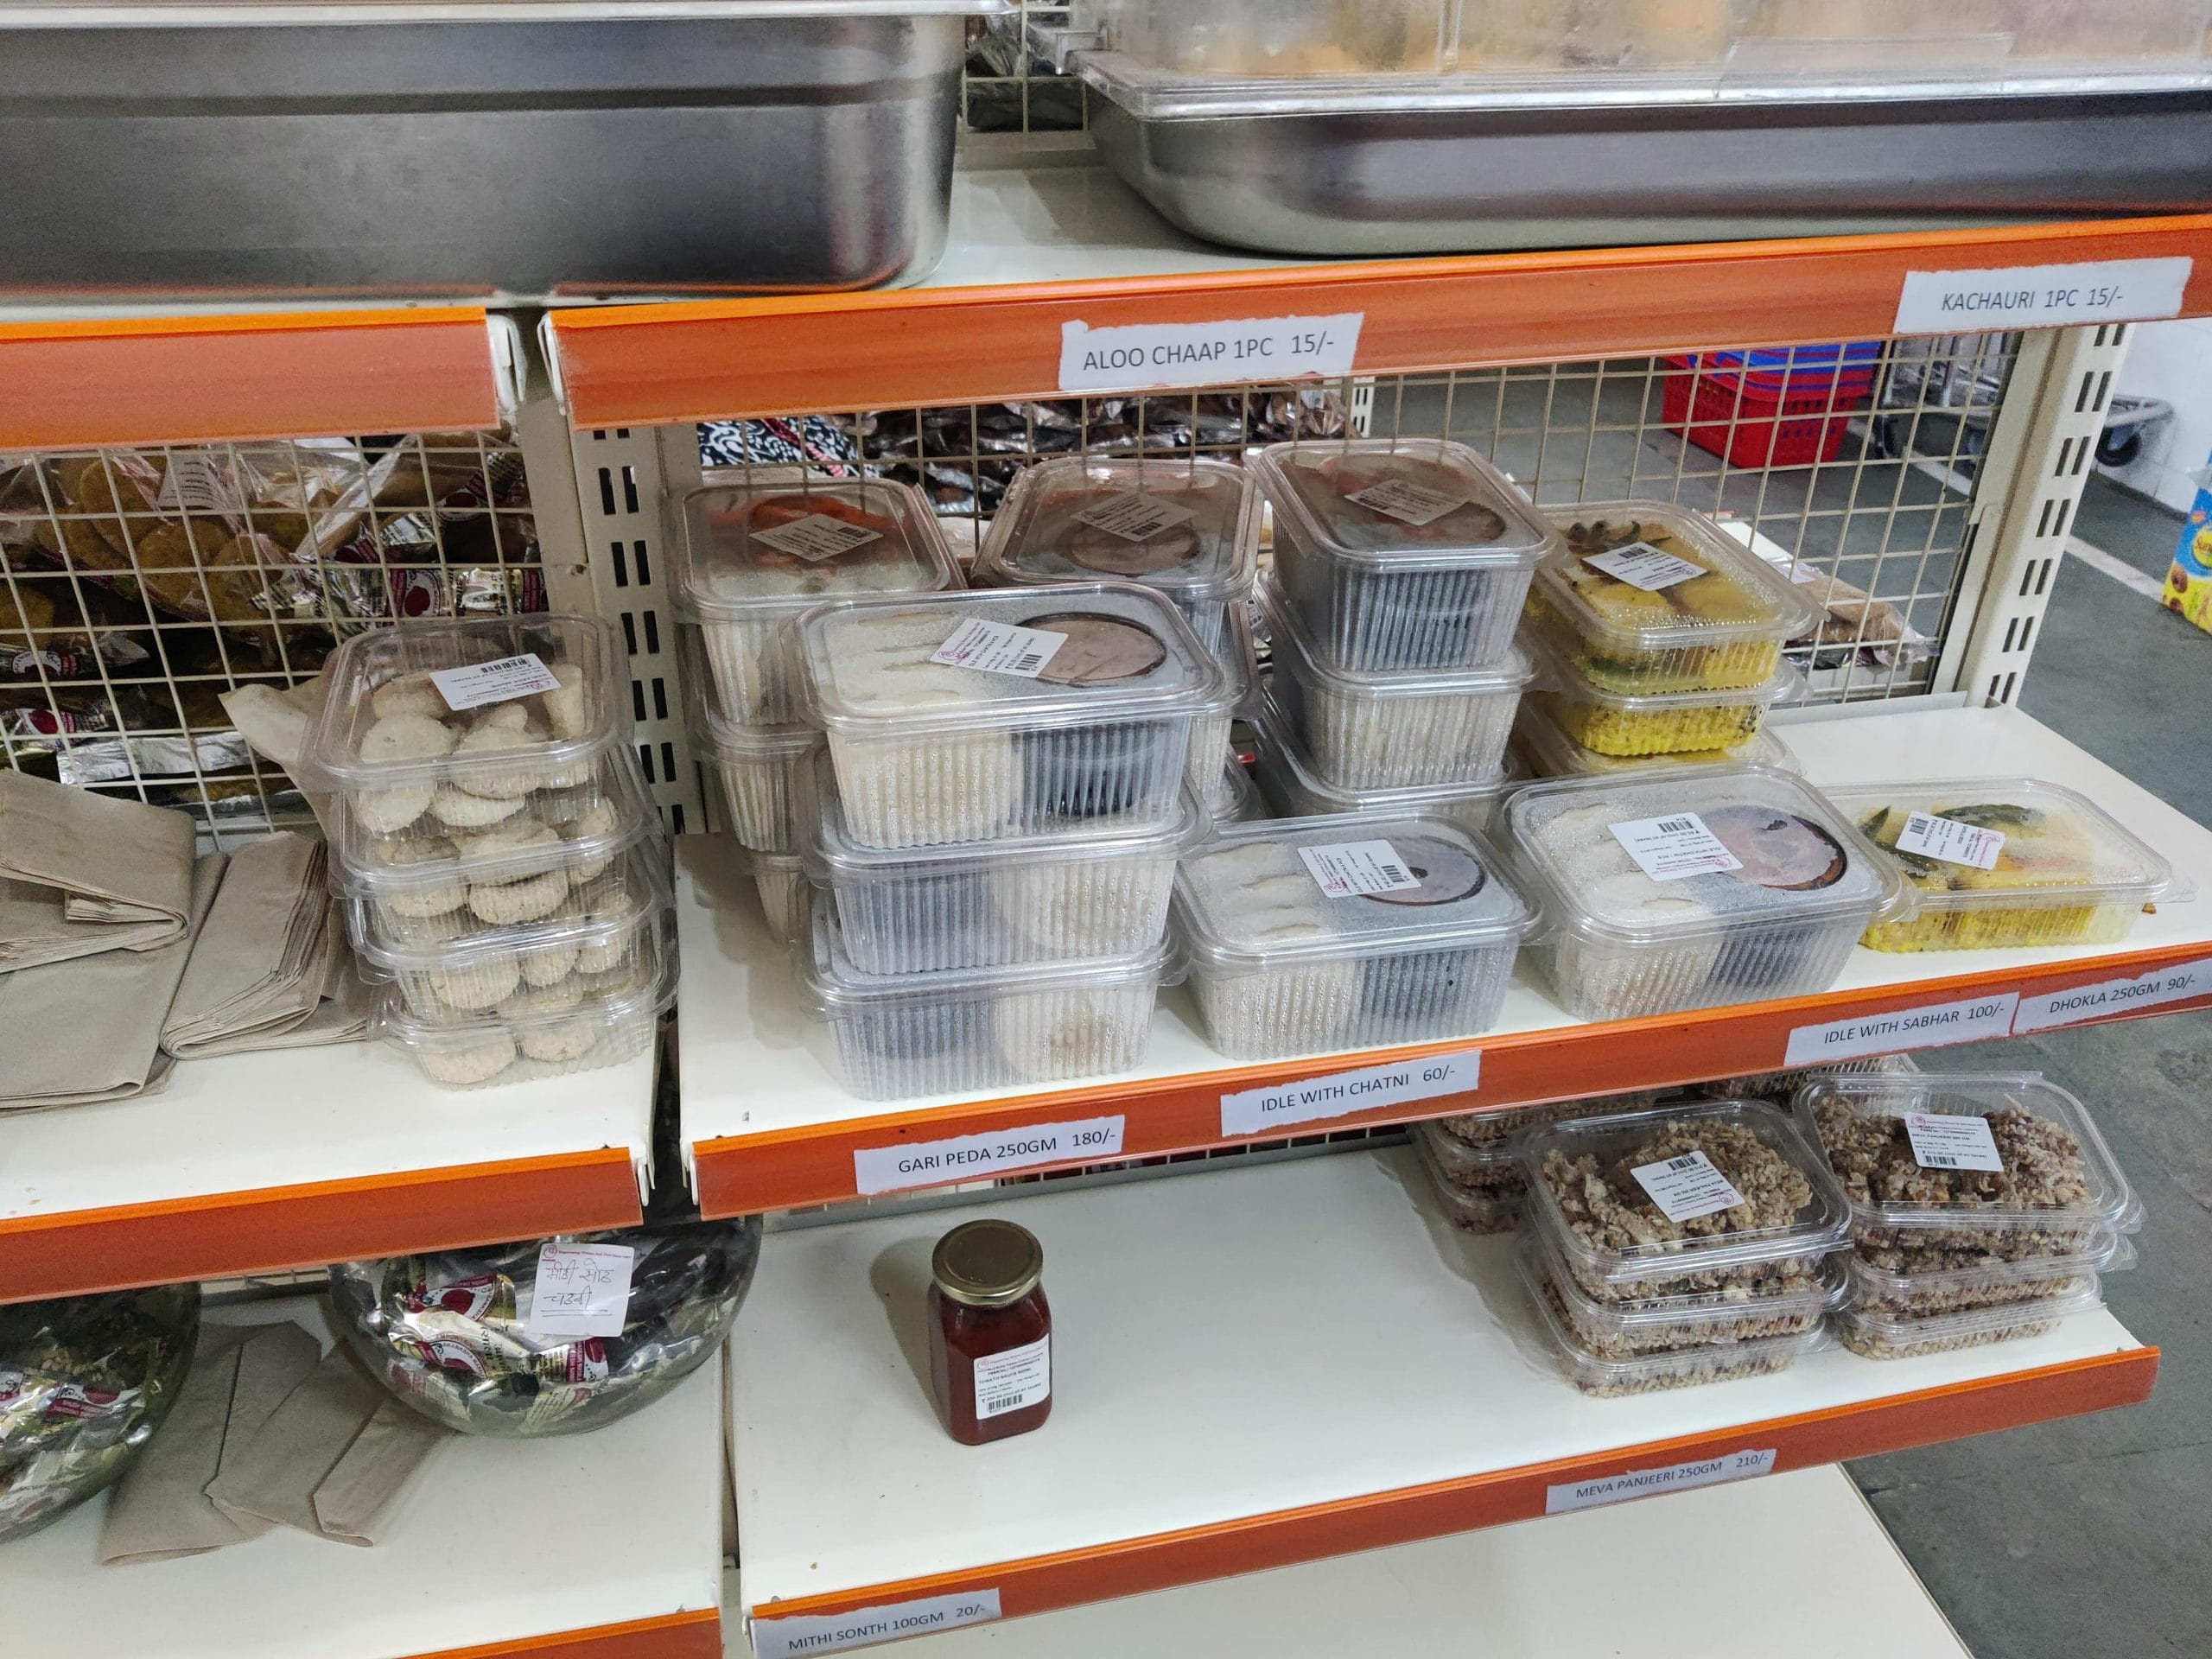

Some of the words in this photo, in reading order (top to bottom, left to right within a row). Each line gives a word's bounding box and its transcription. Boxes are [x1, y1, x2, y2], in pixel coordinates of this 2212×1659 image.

[1942, 289, 2034, 311] KACHAURI
[2044, 289, 2078, 308] 1PC
[2087, 285, 2123, 308] 15/-
[1084, 346, 1145, 371] ALOO
[1152, 341, 1226, 365] CHAAP
[1233, 337, 1273, 359] 1PC
[1291, 331, 1335, 355] 15/-
[2049, 991, 2107, 1014] DHOKLA
[2110, 981, 2161, 1003] 250GM
[2166, 974, 2196, 993] 90/-
[1824, 1027, 1855, 1045] IDLE
[1859, 1020, 1899, 1039] WITH
[1902, 1010, 1960, 1032] SABHAR
[1967, 1002, 2005, 1021] 100/-
[1262, 1094, 1295, 1112] IDLE
[1300, 1084, 1344, 1104] WITH
[1349, 1073, 1409, 1095] CHATNI
[1423, 1064, 1456, 1082] 60/-
[899, 1156, 940, 1173] GARI
[946, 1147, 991, 1166] PEDA
[996, 1137, 1057, 1159] 250GM
[1071, 1128, 1116, 1147] 180/-
[1576, 1482, 1613, 1498] MEVA
[1617, 1471, 1675, 1491] PANJEERI
[1678, 1462, 1722, 1479] 250GM
[1736, 1452, 1770, 1468] 210/-
[788, 1633, 832, 1650] MITHI
[836, 1623, 887, 1641] SONTH
[893, 1611, 944, 1630] 100GM
[956, 1604, 986, 1618] 20/-
